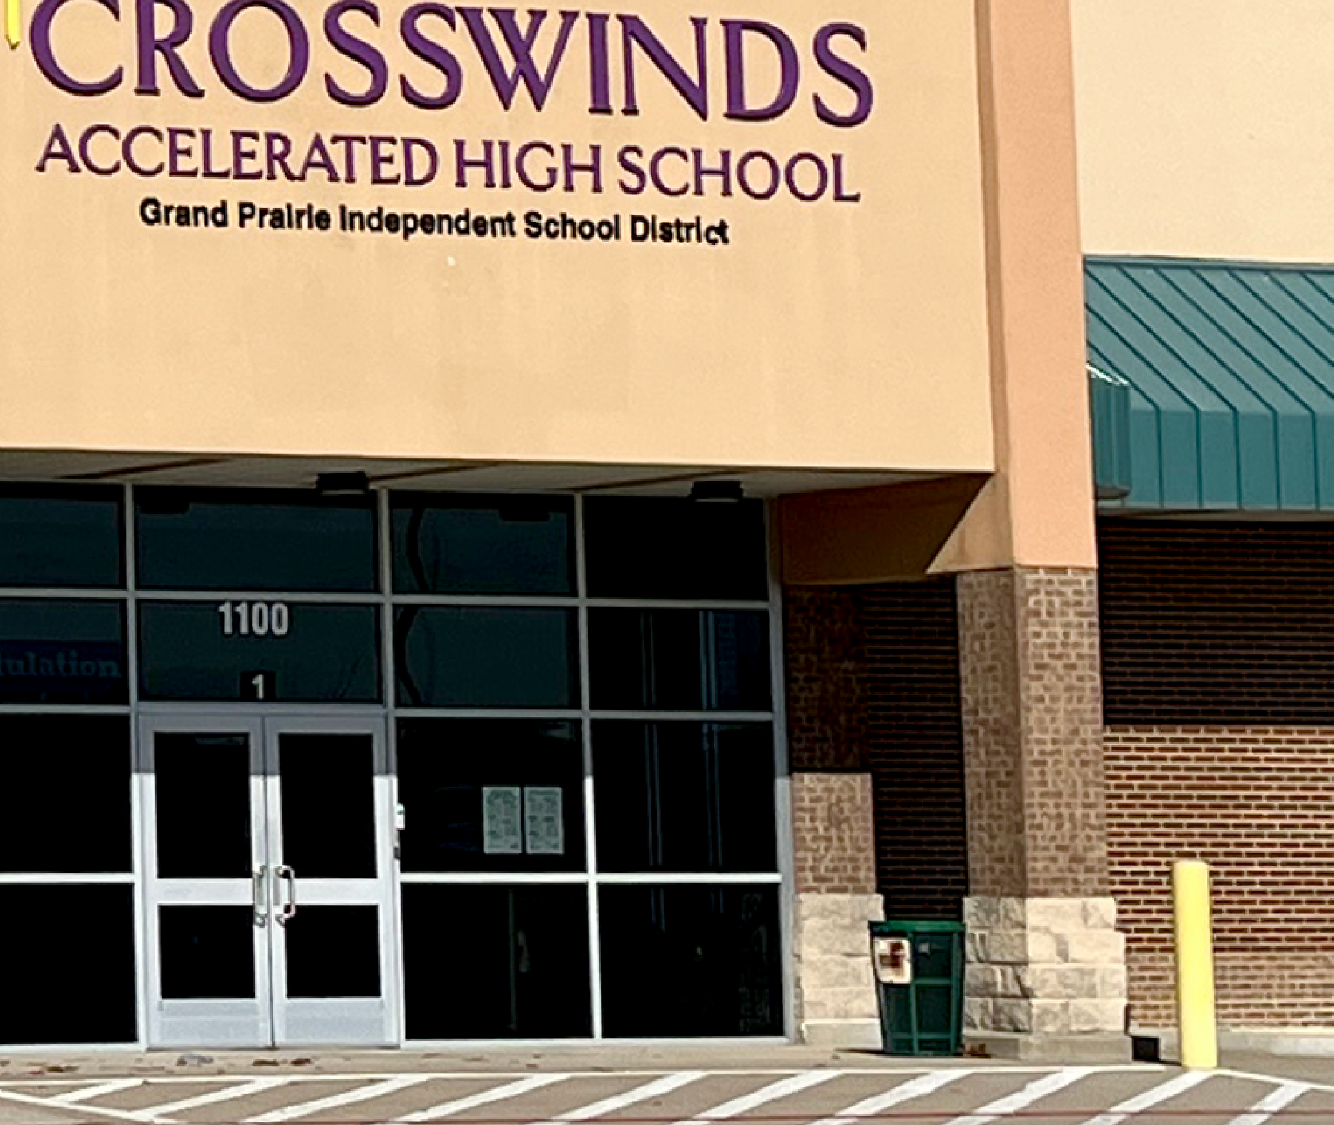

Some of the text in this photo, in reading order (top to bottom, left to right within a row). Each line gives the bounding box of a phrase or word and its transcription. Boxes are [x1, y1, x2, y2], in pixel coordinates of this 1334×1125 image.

[35, 123, 861, 204] ACCELERATED HIGH SCHOOL
[138, 196, 730, 247] Grand Prairie Independent School District
[218, 600, 290, 637] 1100
